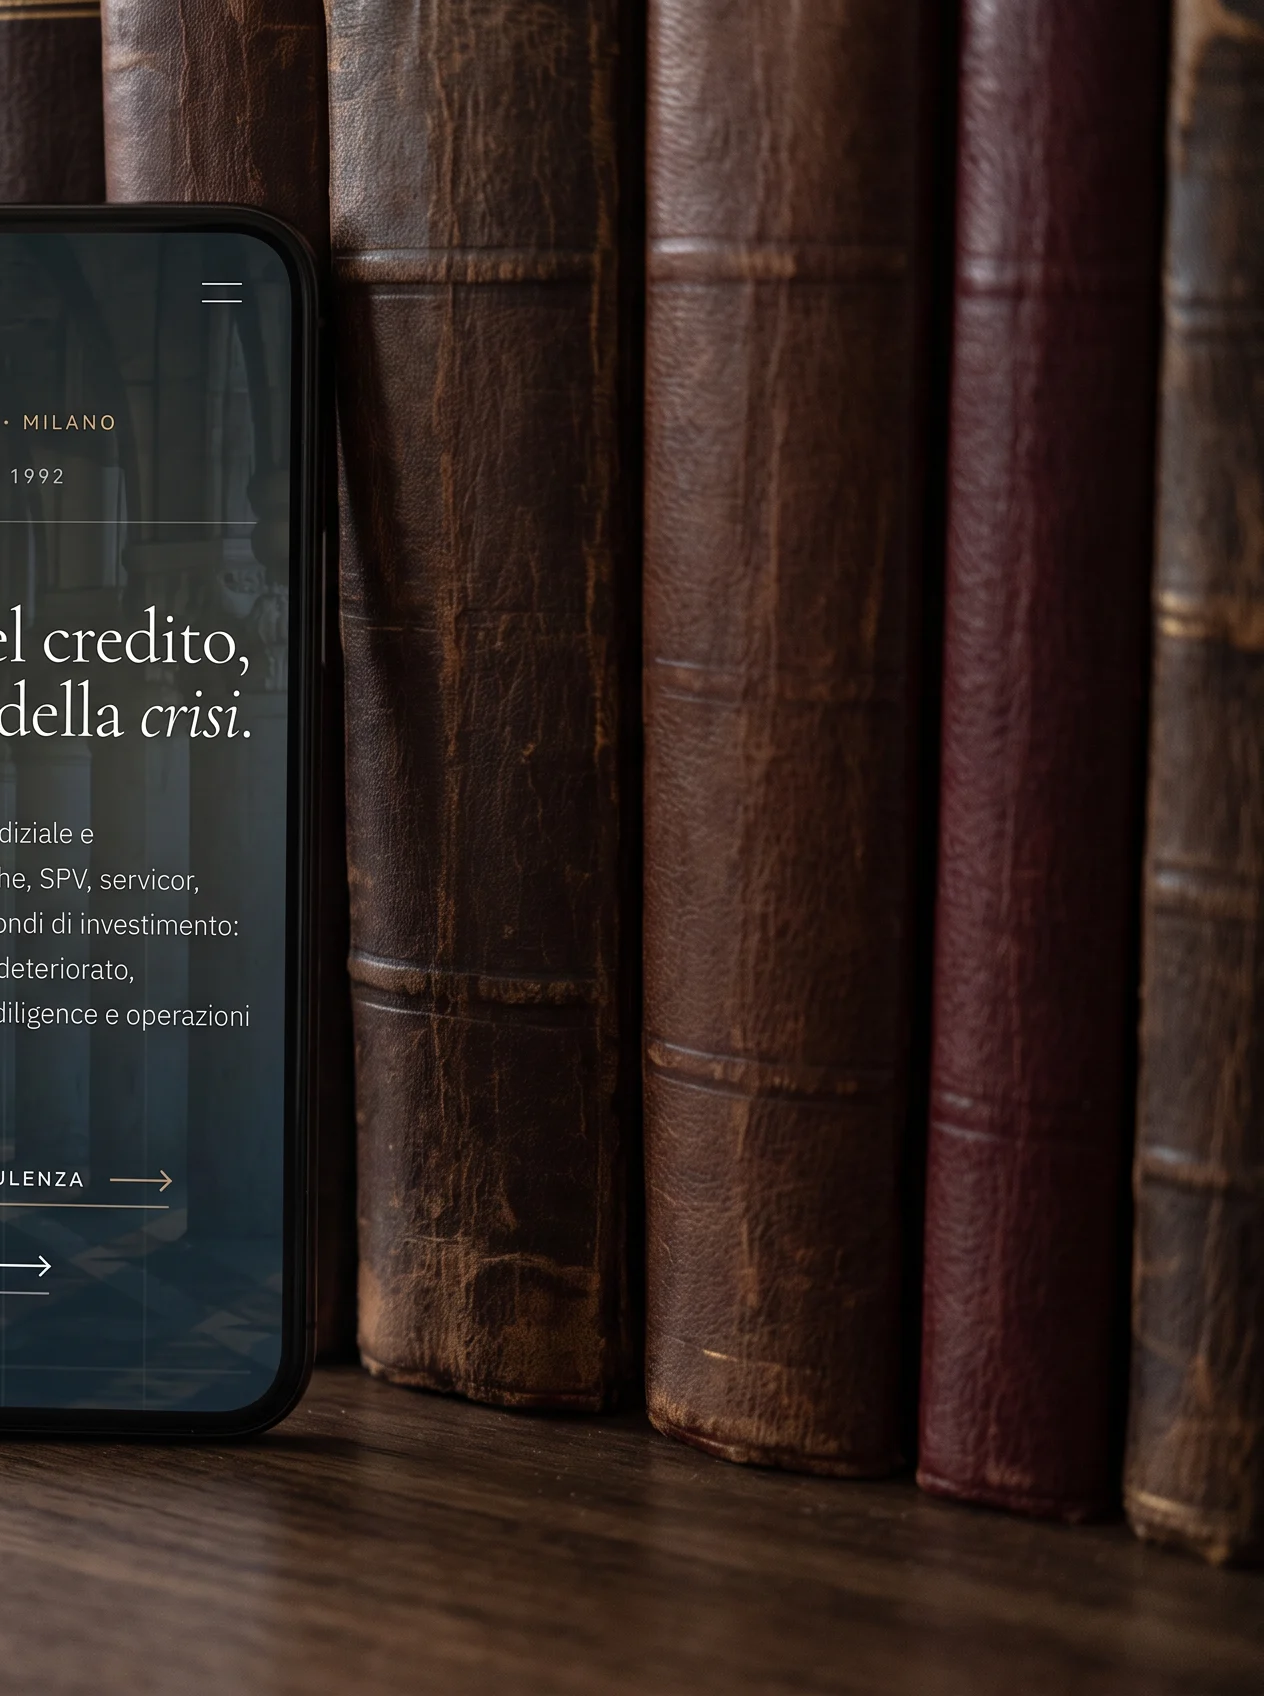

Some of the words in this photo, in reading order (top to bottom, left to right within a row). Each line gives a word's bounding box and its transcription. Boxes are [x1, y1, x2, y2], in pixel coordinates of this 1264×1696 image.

[23, 414, 115, 431] MILANO
[10, 468, 64, 485] 1992
[43, 604, 249, 677] credito,
[140, 689, 251, 739] crisi.
[80, 827, 94, 845] e
[40, 867, 92, 894] SPV,
[100, 867, 199, 895] servicor,
[51, 911, 72, 935] di
[80, 911, 239, 937] investimento:
[105, 1008, 119, 1026] e
[126, 1003, 250, 1032] operazioni
